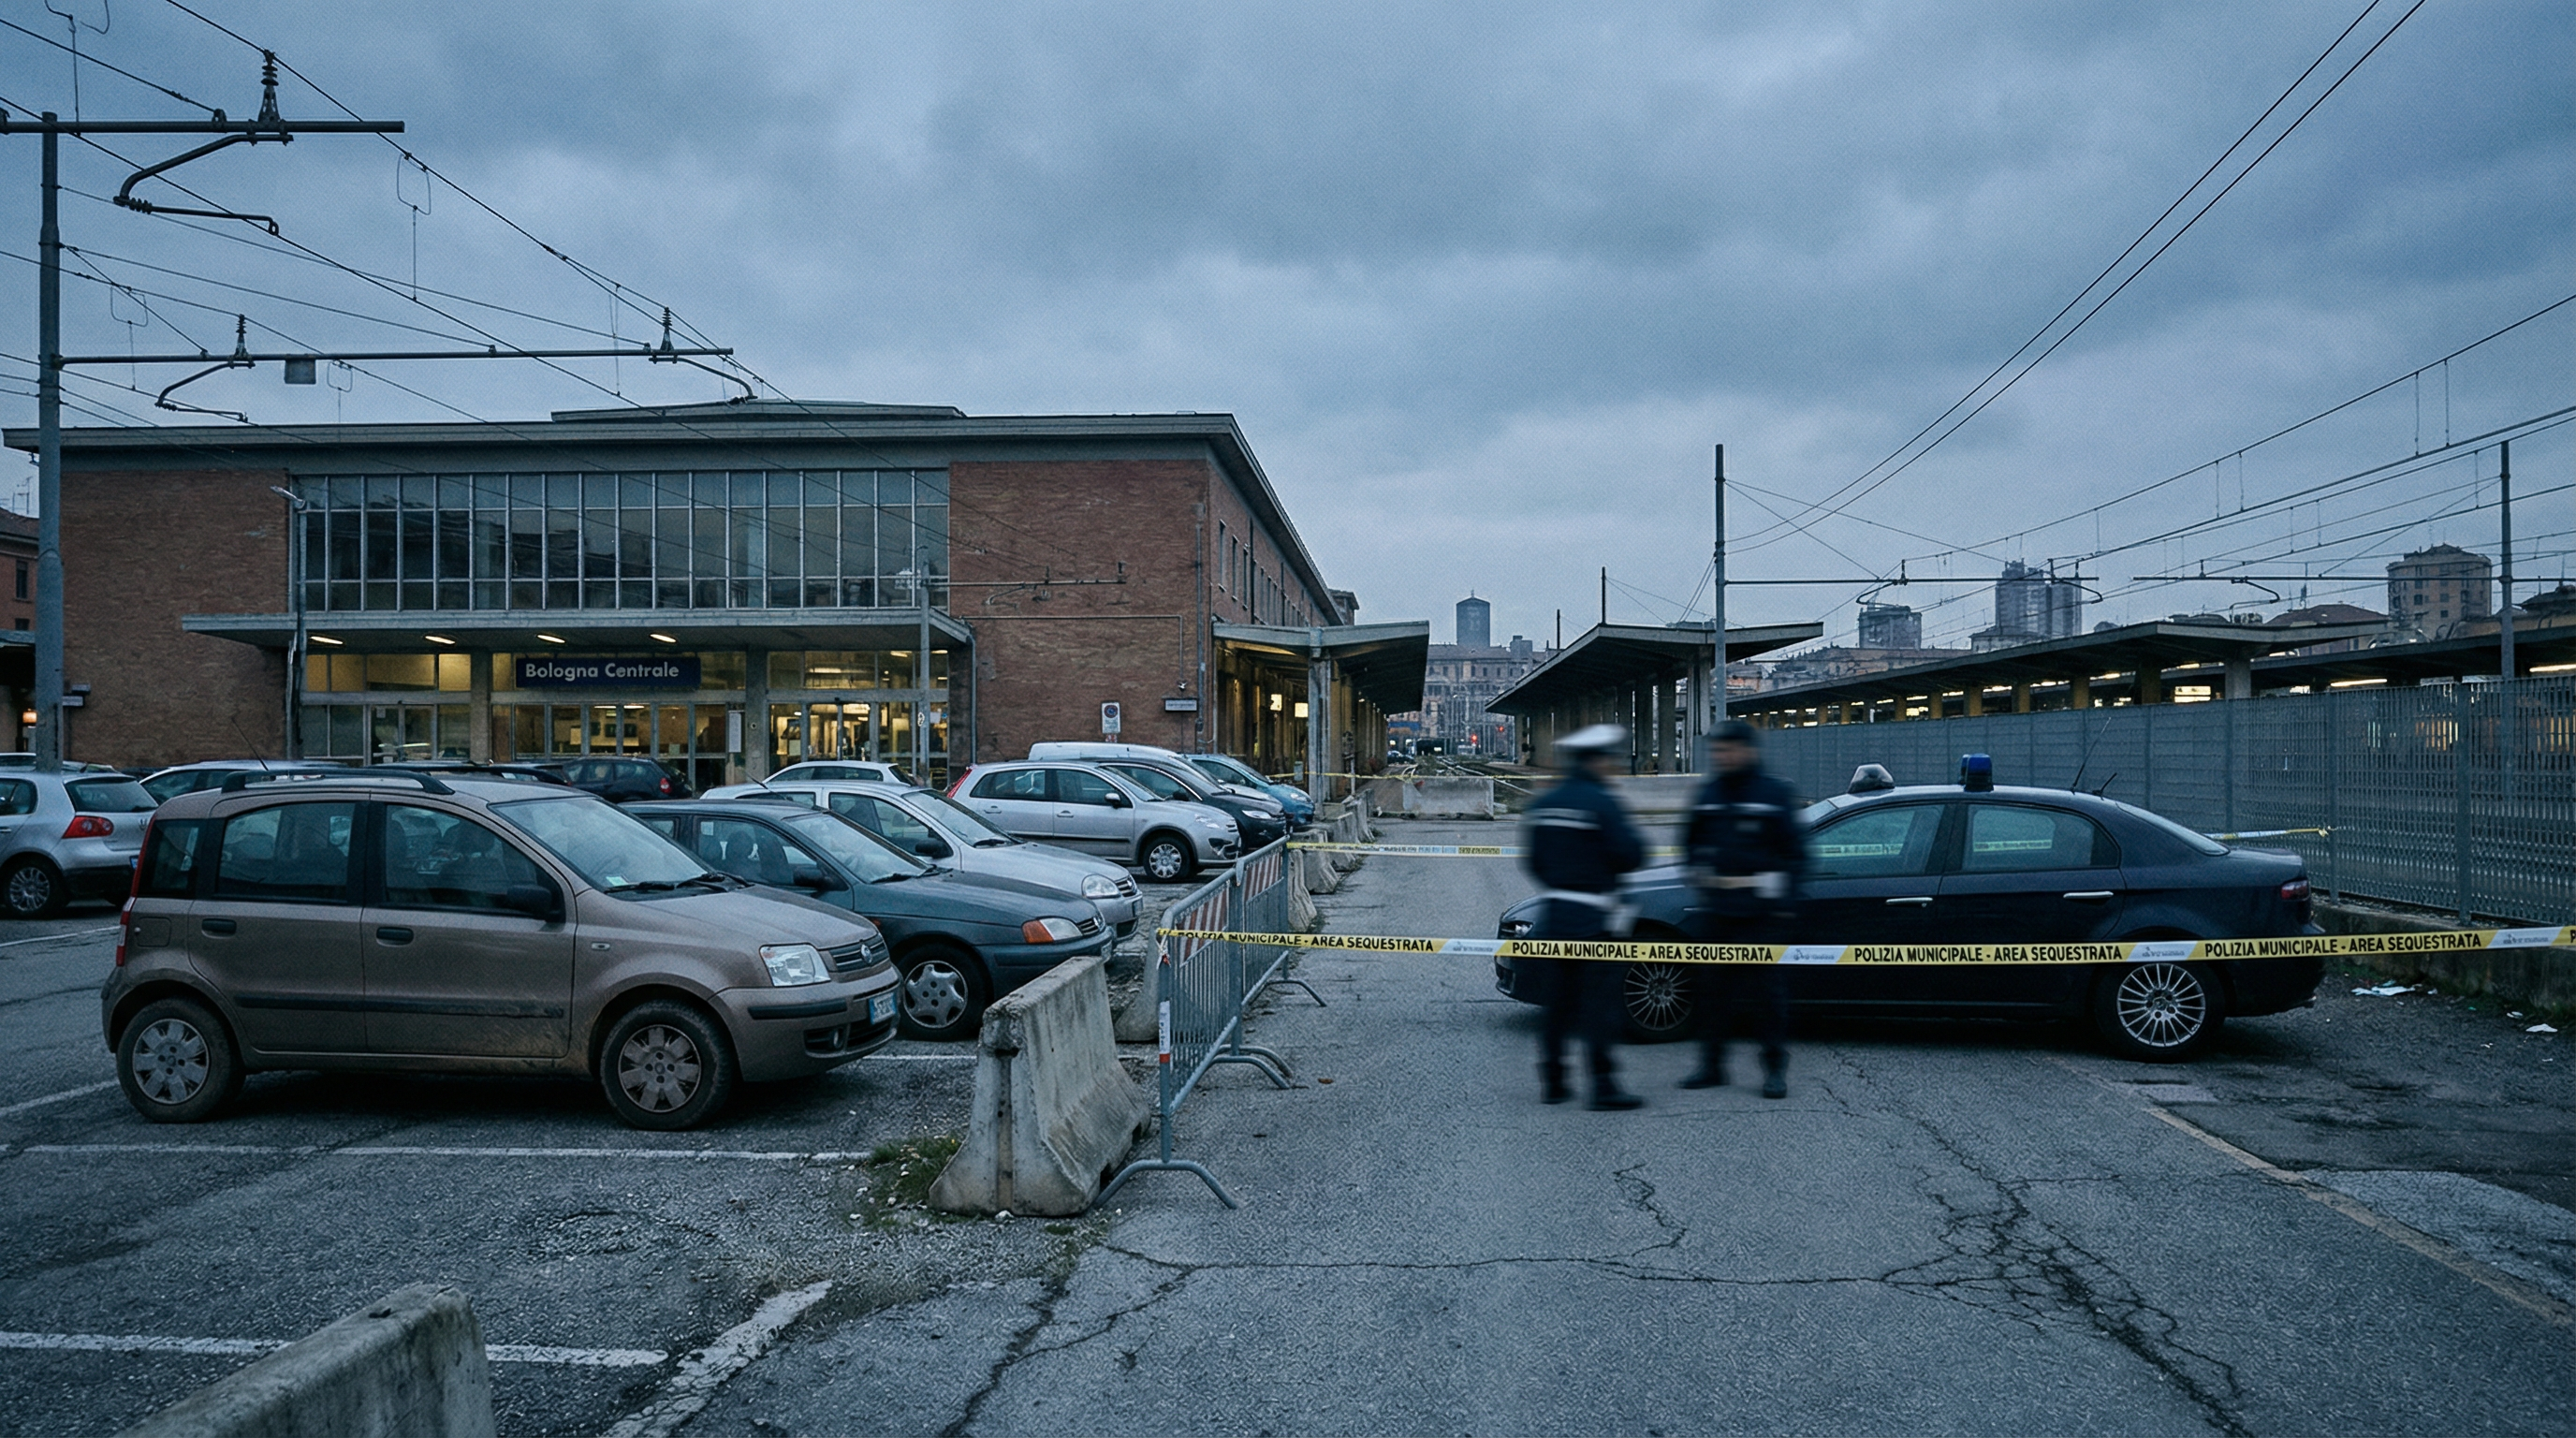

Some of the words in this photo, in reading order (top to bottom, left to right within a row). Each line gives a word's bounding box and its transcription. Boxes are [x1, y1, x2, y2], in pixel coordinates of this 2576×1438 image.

[525, 663, 598, 682] Bologna
[605, 662, 680, 678] Centrale
[1311, 936, 1344, 947] AREA
[1347, 937, 1433, 951] SEQUESTRATA
[1512, 942, 1560, 957] POLIZIA
[1564, 943, 1638, 959] MUNICIPALE
[1648, 945, 1682, 960] AREA
[1685, 946, 1773, 961] SEQUESTRATA
[2204, 942, 2256, 958] POLIZIA
[2259, 939, 2338, 956] MUNICIPALE
[2349, 937, 2385, 952] AREA
[2388, 933, 2481, 951] SEQUESTRATA
[1854, 947, 1904, 962] POLIZIA
[1907, 946, 1983, 962] MUNICIPALE
[1994, 946, 2028, 961] AREA
[2031, 946, 2122, 961] SEQUESTRATA
